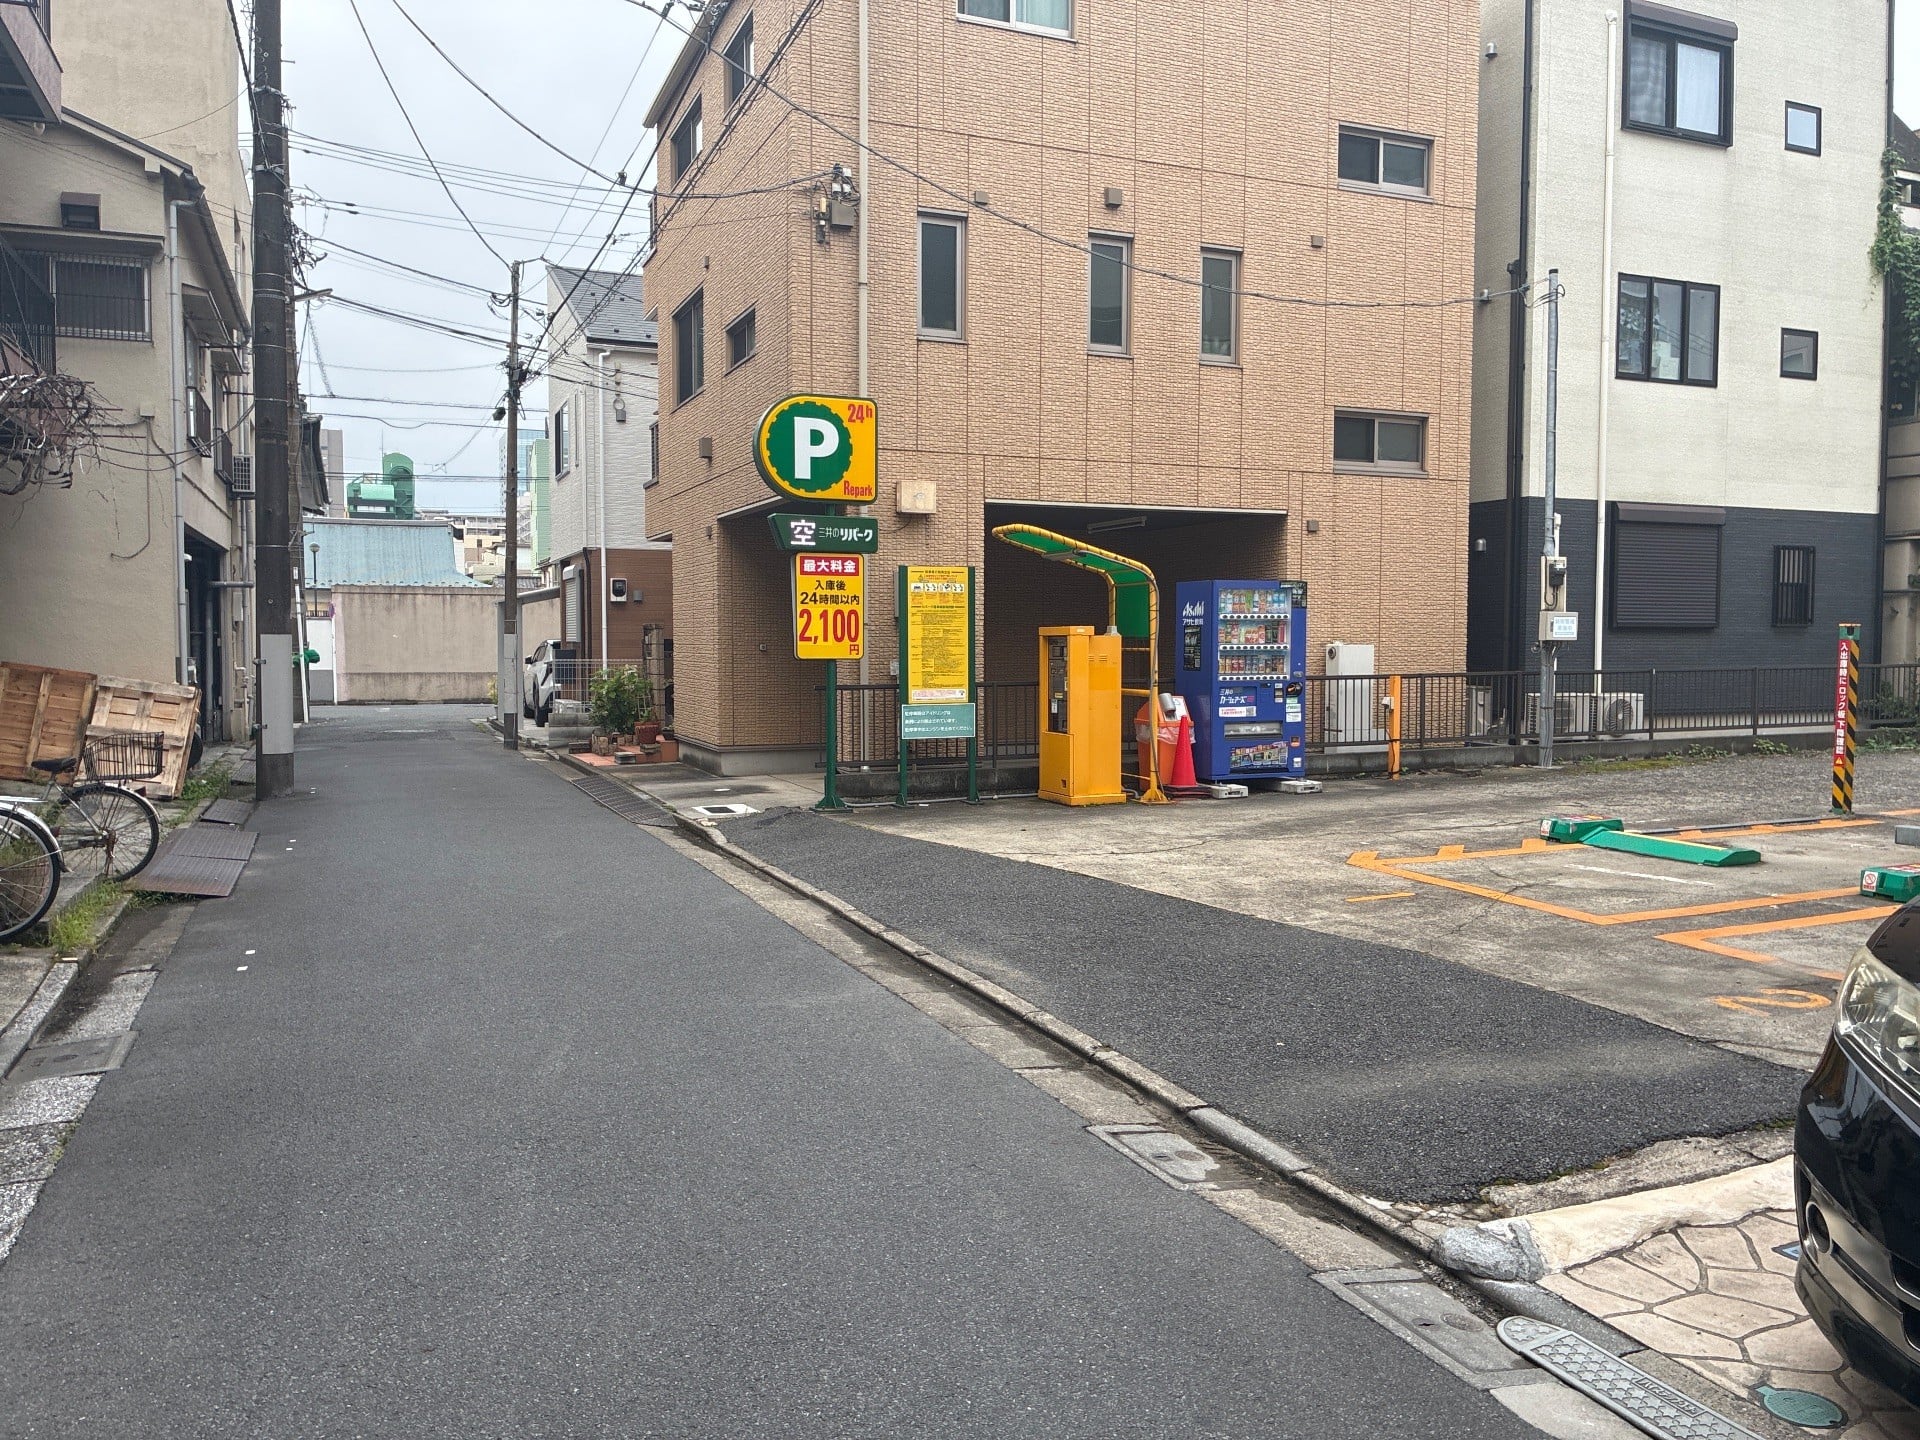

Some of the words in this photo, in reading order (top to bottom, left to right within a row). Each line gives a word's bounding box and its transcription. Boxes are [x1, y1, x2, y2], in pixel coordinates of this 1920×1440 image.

[848, 404, 872, 423] 24h
[794, 417, 839, 480] P
[843, 480, 873, 498] Repark
[790, 519, 816, 545] 空
[818, 527, 873, 542] 三井のリパーク
[803, 559, 856, 573] 最大料金
[814, 579, 846, 591] 入庫後
[800, 592, 860, 605] 24時間以内
[1182, 601, 1205, 617] Asahi
[798, 608, 860, 644] 2,100
[849, 644, 860, 656] 円
[1219, 688, 1234, 696] 三井の
[1712, 988, 1832, 1017] 2
